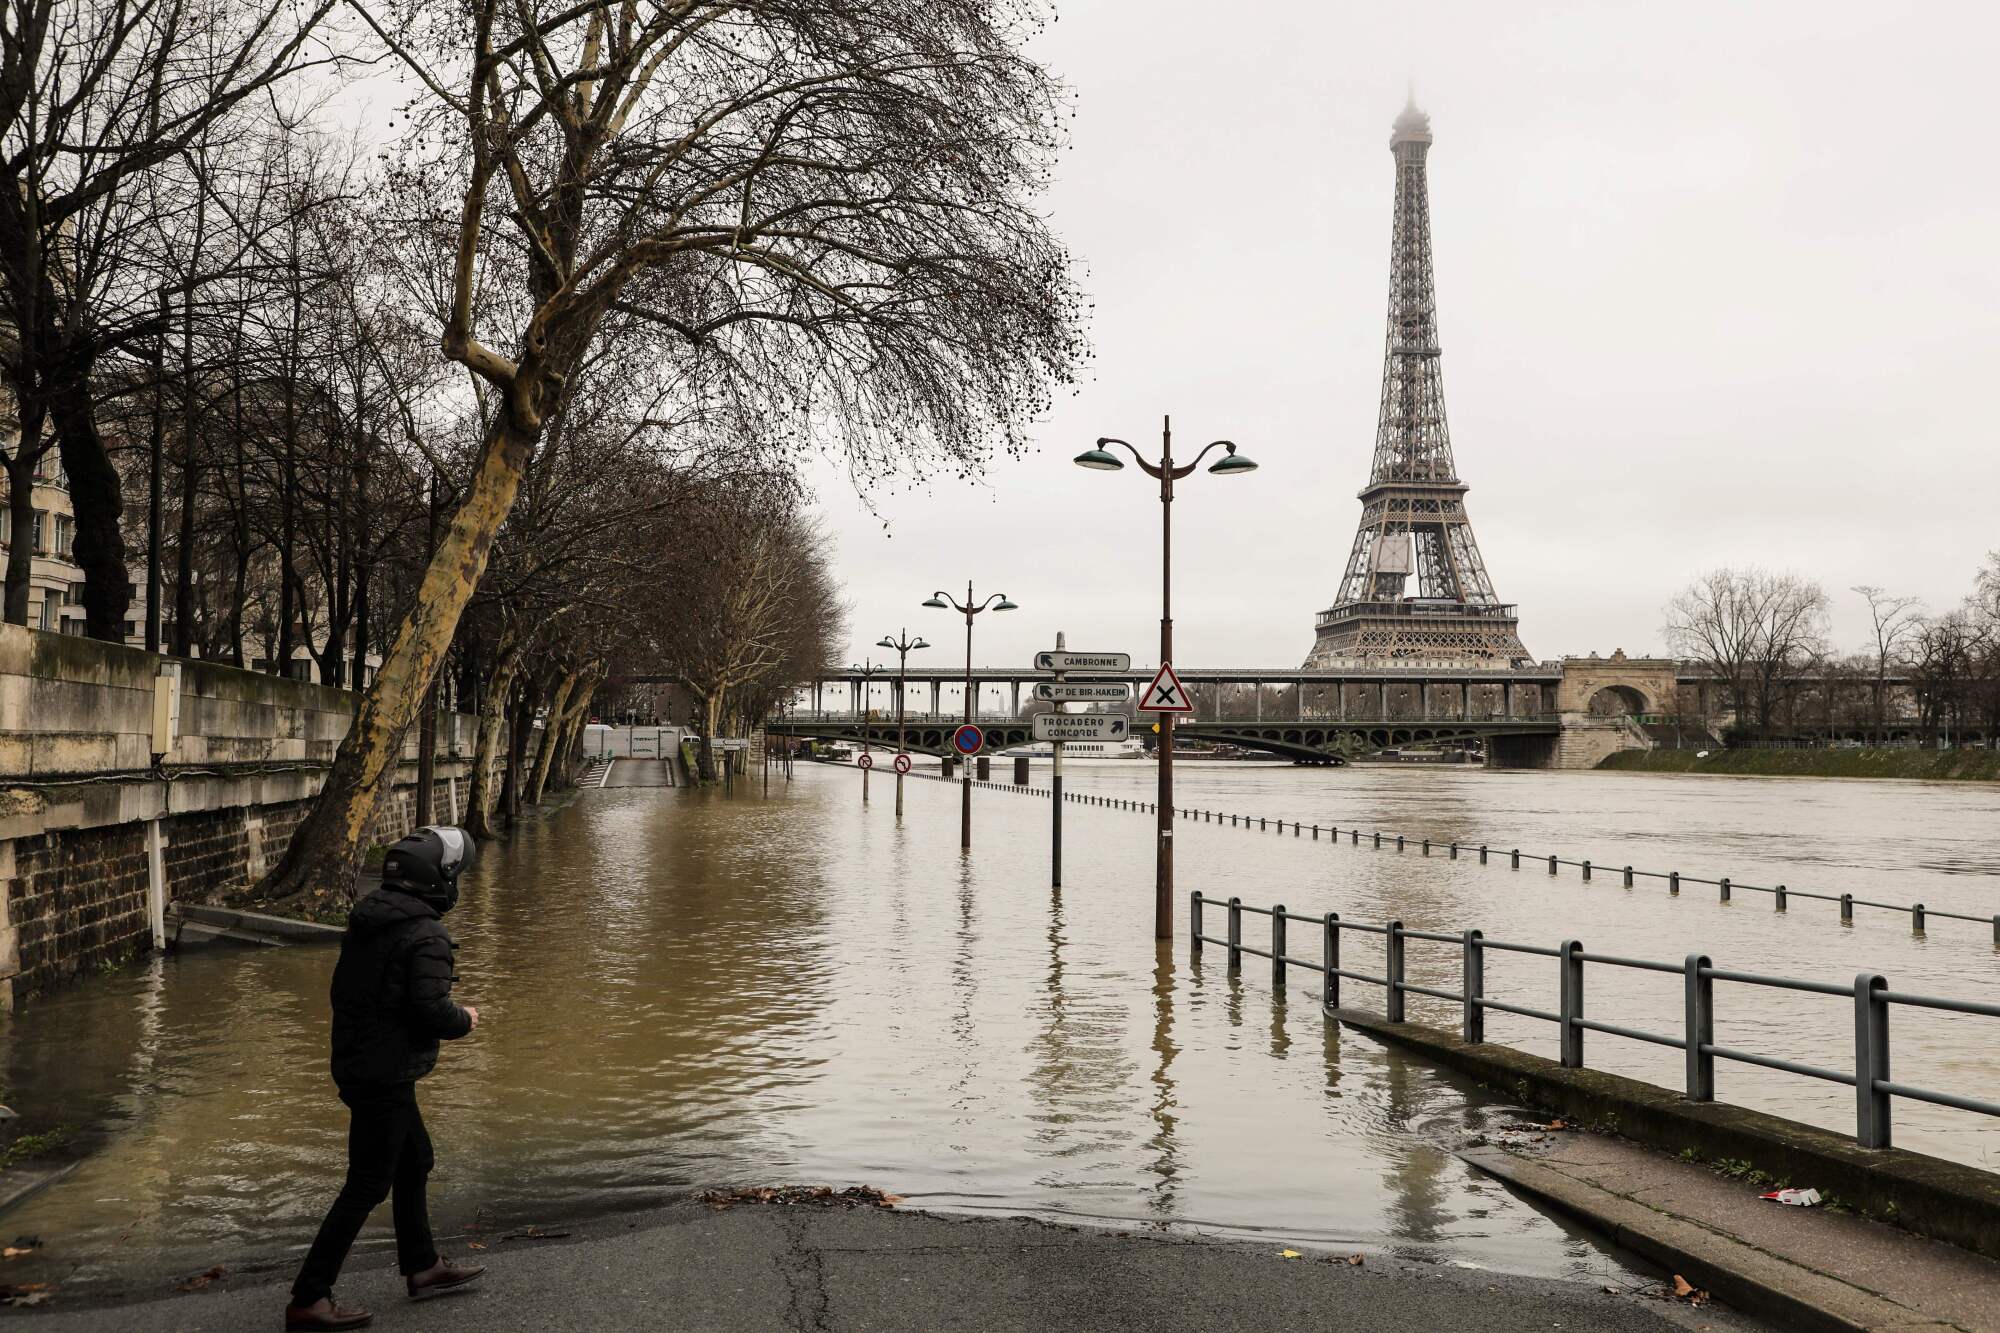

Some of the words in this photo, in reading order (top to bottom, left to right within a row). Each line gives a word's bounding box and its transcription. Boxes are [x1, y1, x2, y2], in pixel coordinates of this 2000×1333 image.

[1064, 658, 1118, 666] CAMBRONNE
[1066, 688, 1077, 696] DE
[1043, 717, 1104, 726] TROCADÉRO
[1048, 729, 1098, 737] CONCORDE
